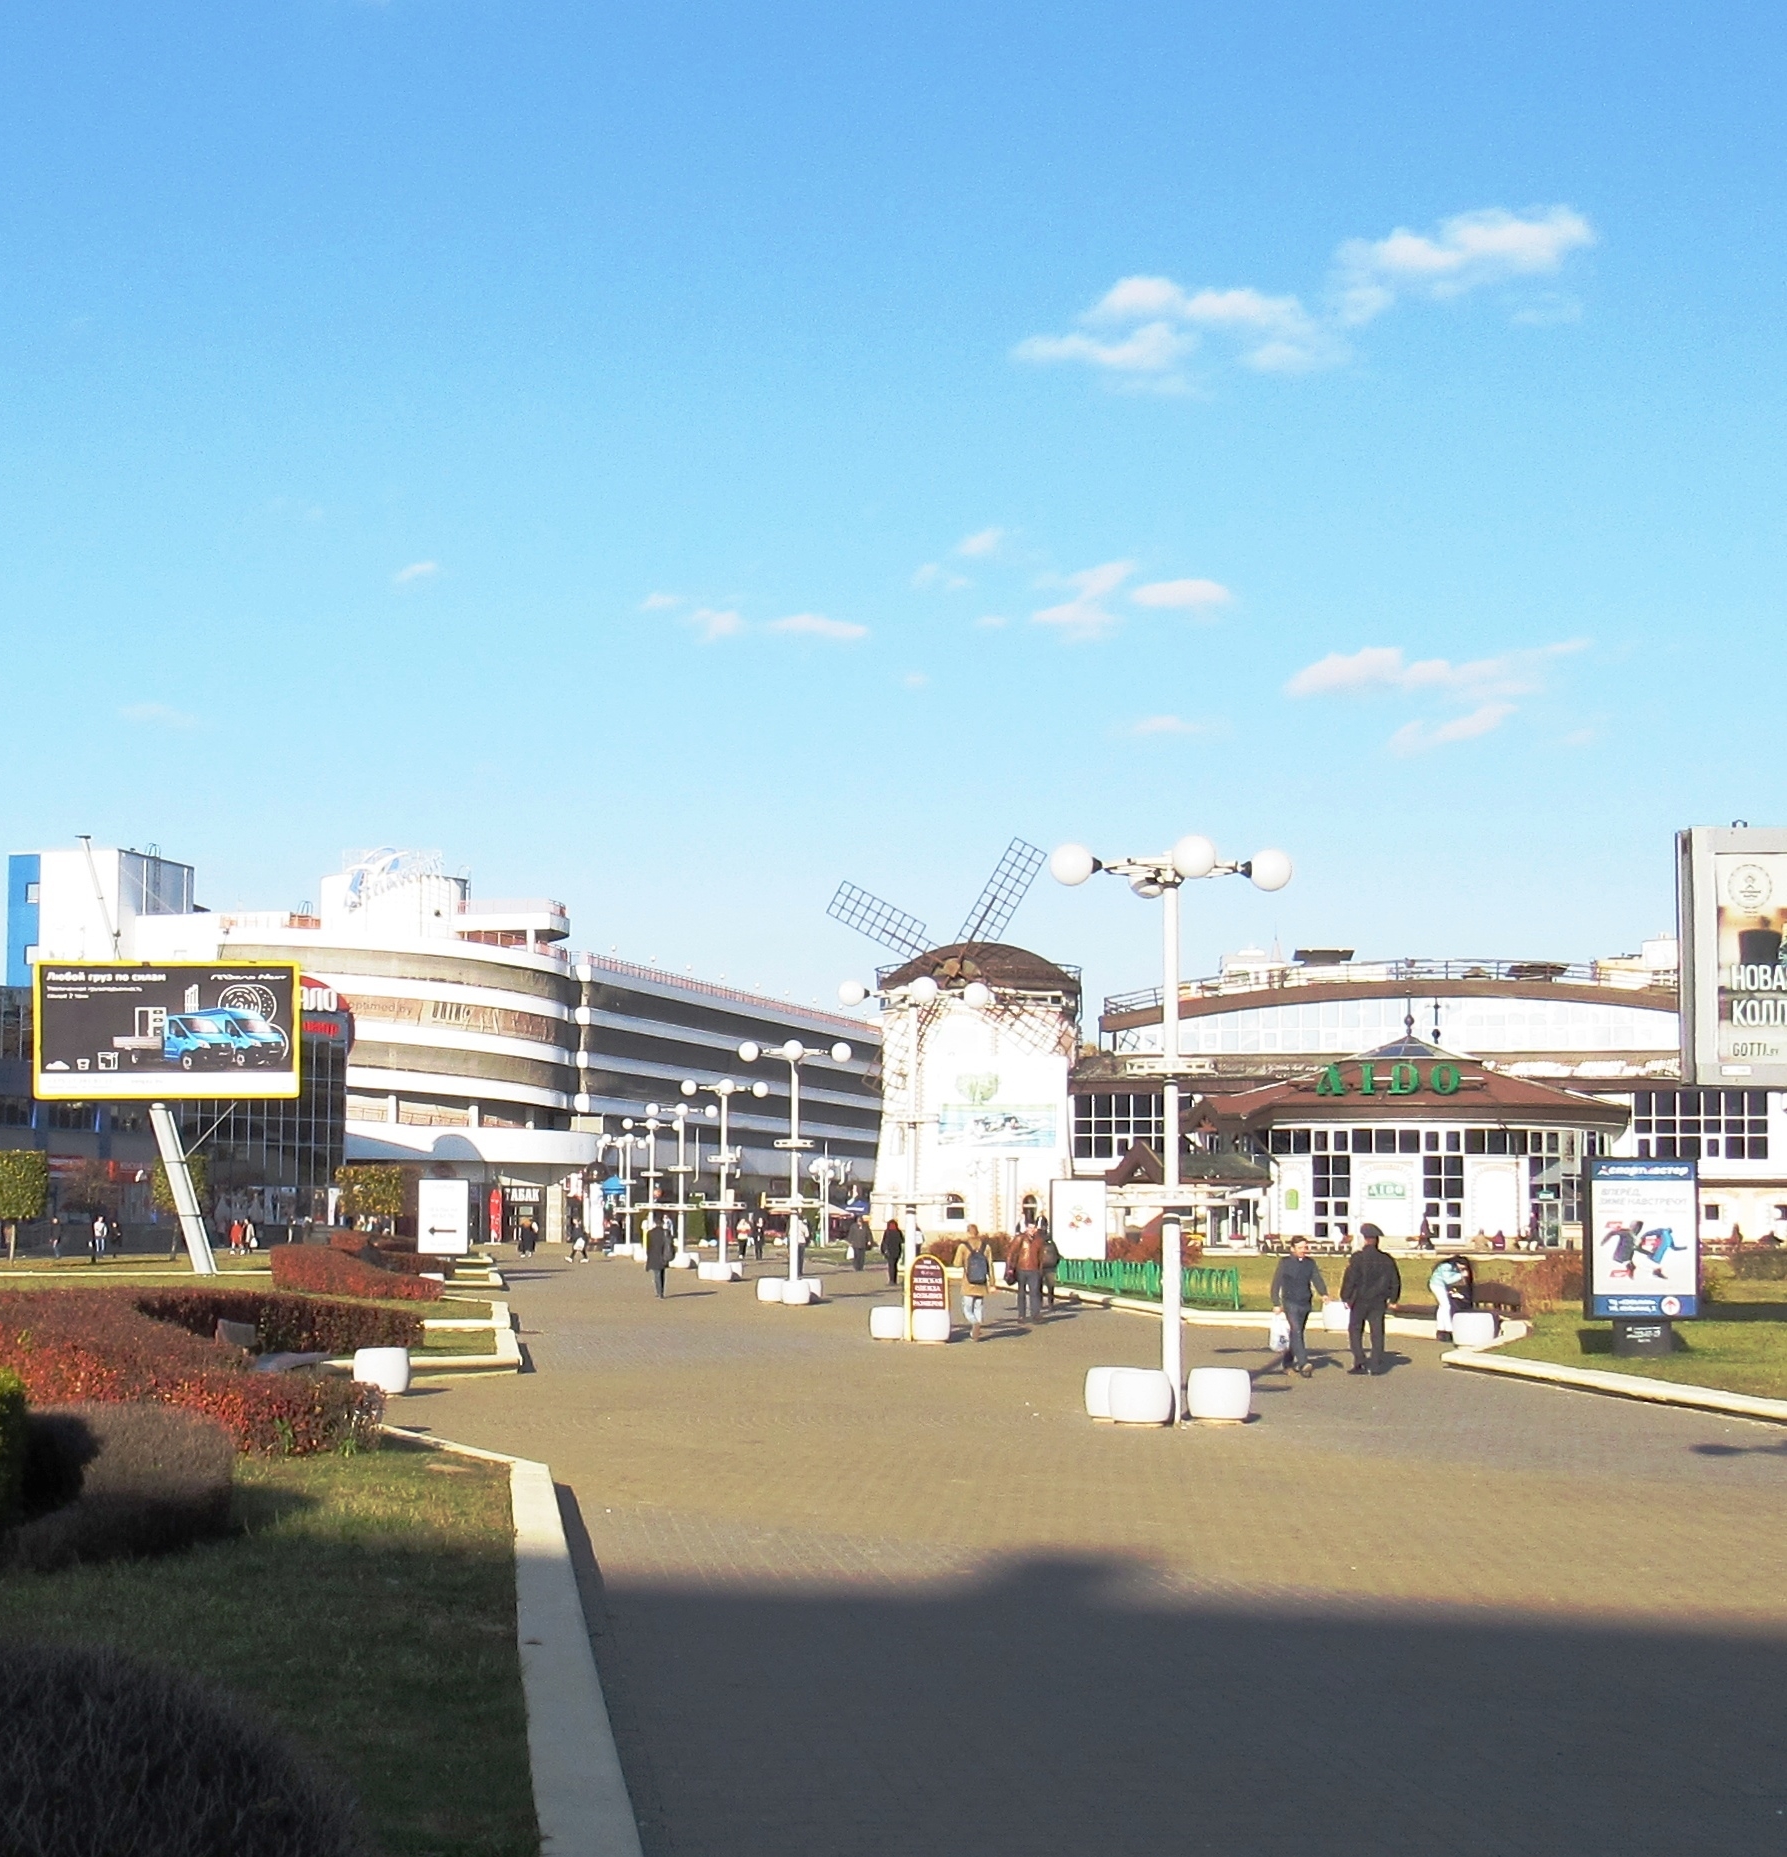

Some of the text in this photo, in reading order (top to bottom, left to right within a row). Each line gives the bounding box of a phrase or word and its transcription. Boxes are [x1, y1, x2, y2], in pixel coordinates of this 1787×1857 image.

[46, 971, 86, 981] Любой
[115, 973, 129, 981] по
[1731, 964, 1787, 991] НОВА
[1732, 999, 1787, 1027] КОЛЛ
[1316, 1062, 1461, 1096] AIDO
[504, 1187, 540, 1202] ТАБАК
[1368, 1184, 1404, 1196] AIDO
